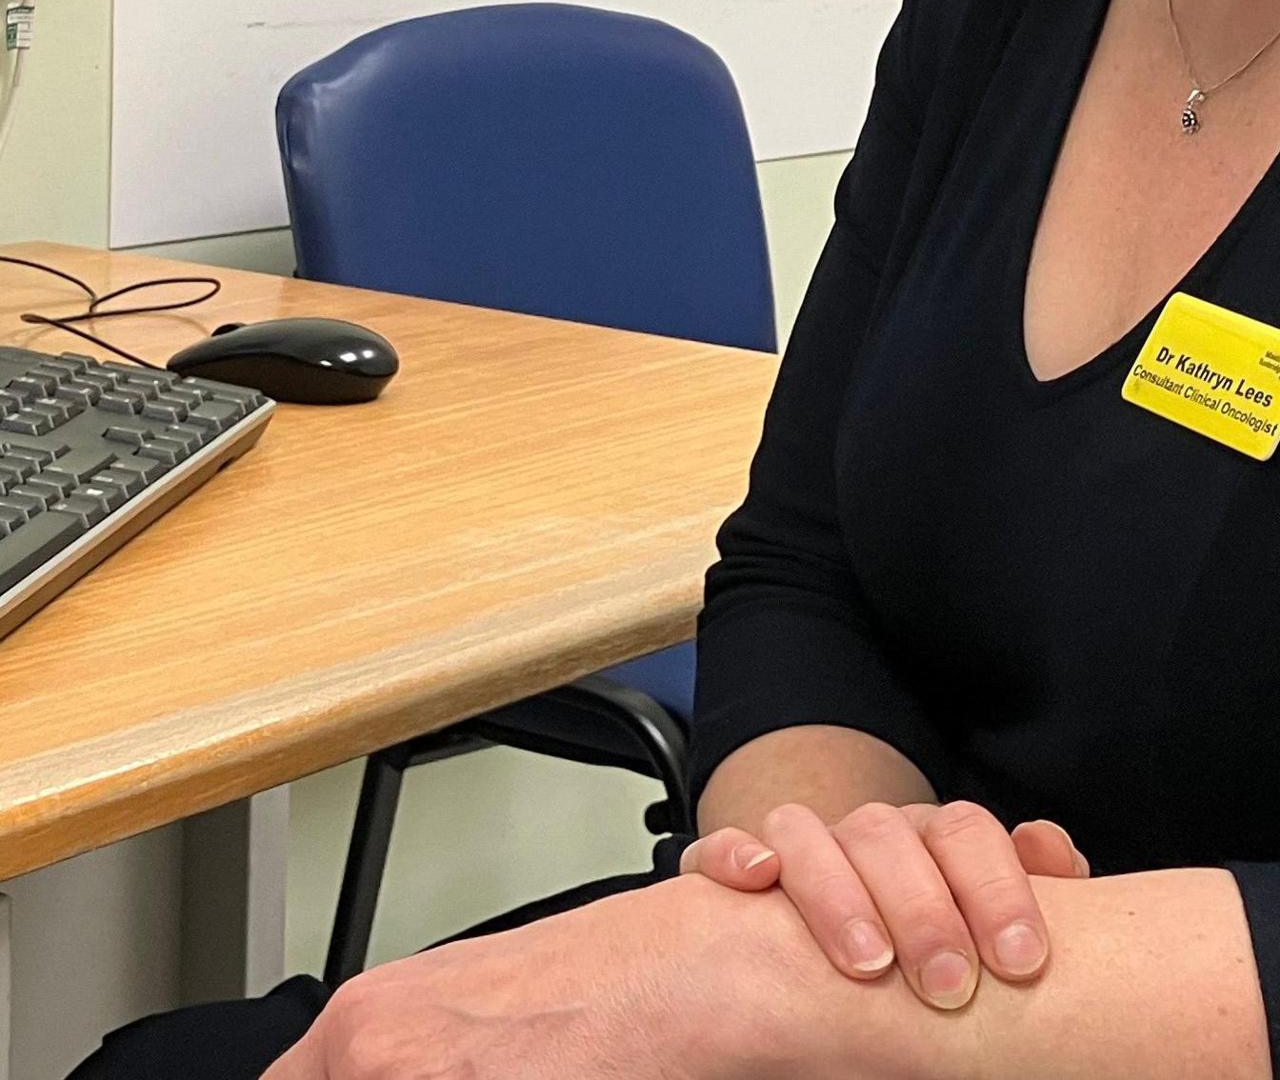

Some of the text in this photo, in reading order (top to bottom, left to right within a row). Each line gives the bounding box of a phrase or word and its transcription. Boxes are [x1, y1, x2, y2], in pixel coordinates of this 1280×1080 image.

[1132, 364, 1278, 437] Consultant Clinical Oncologist
[1156, 346, 1273, 407] Dr Kathryn Lees
